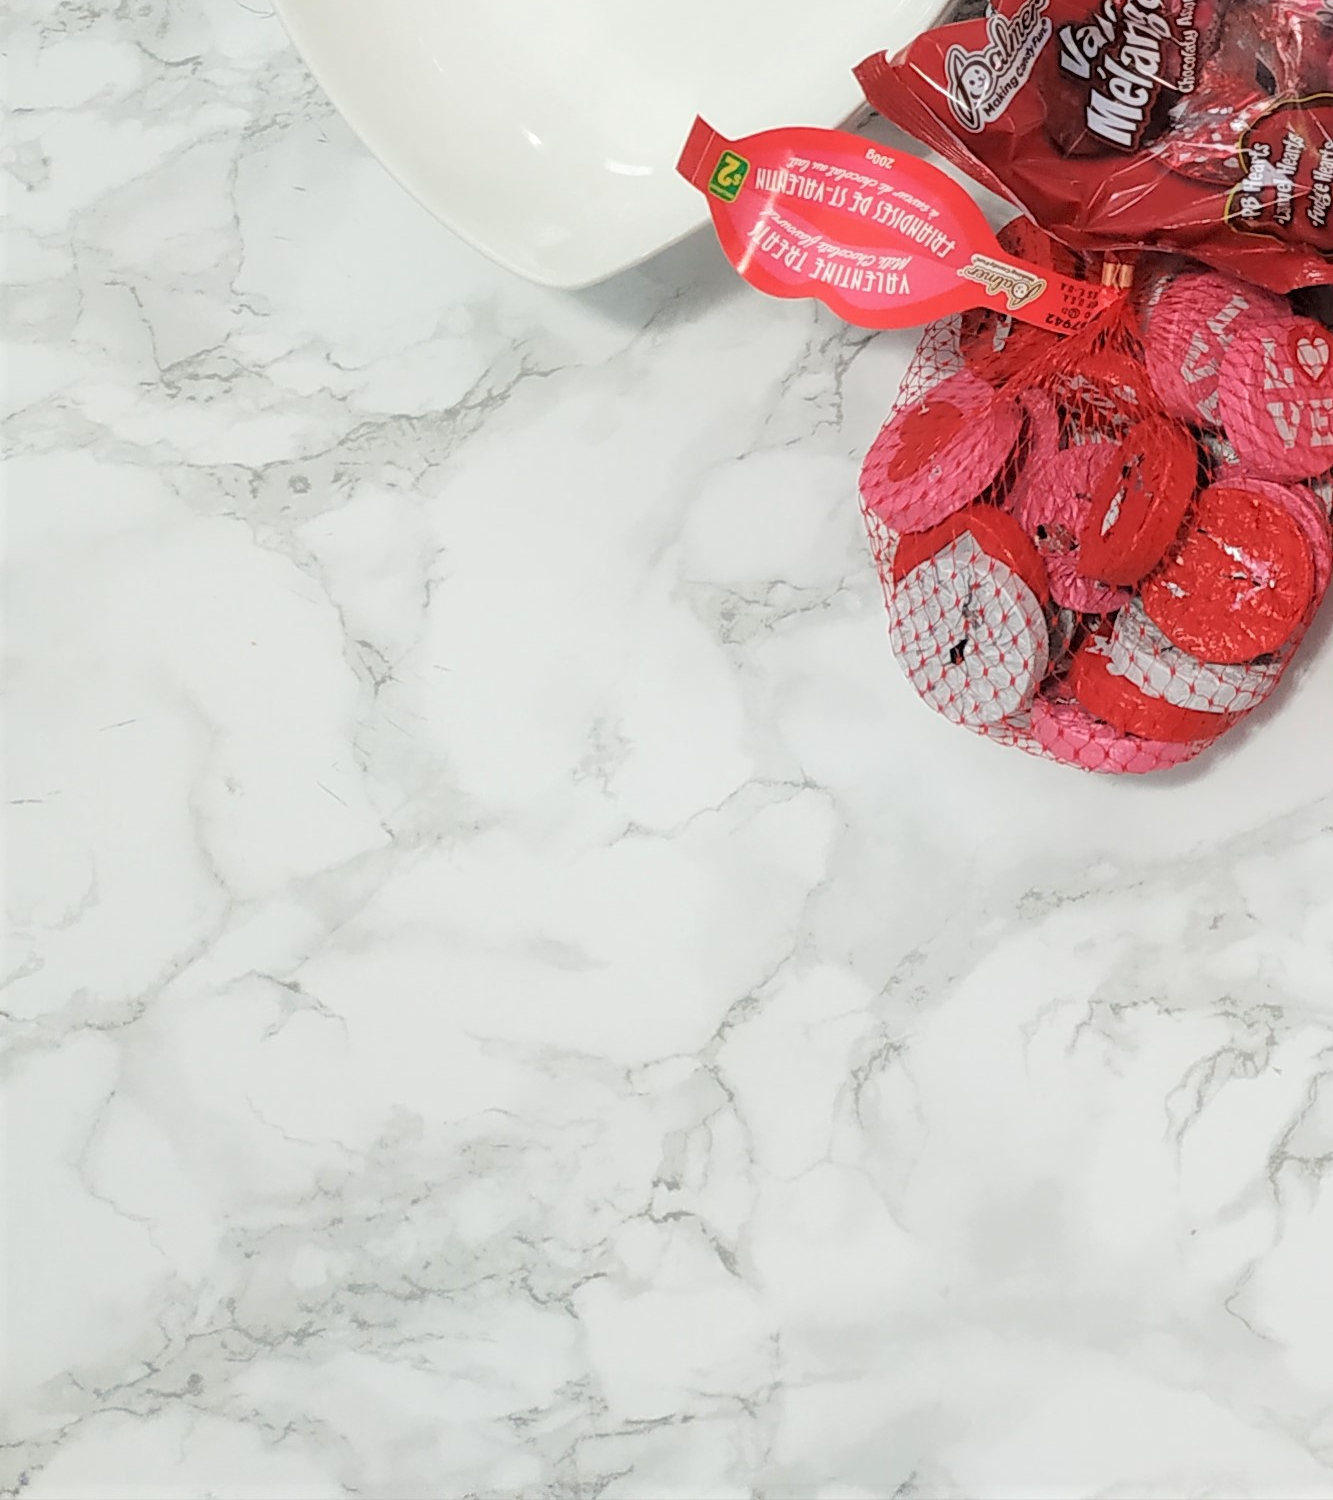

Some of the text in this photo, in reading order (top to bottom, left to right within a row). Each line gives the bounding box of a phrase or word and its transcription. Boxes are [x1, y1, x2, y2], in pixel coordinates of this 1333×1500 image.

[984, 43, 1036, 117] Making Candy
[1178, 29, 1198, 94] Chocolaty
[784, 156, 807, 169] lait
[811, 161, 831, 175] au
[865, 148, 896, 170] 200g
[1243, 142, 1271, 192] Hearts
[1275, 131, 1306, 176] Hearts
[833, 169, 879, 188] chocolat
[755, 167, 956, 259] FRIANDISES DE ST-VALENTIN
[1307, 182, 1332, 225] Fudge
[817, 240, 884, 269] Chocolate
[886, 255, 913, 272] Milk
[809, 256, 911, 295] VALENTINE
[966, 265, 1043, 307] Palmer
